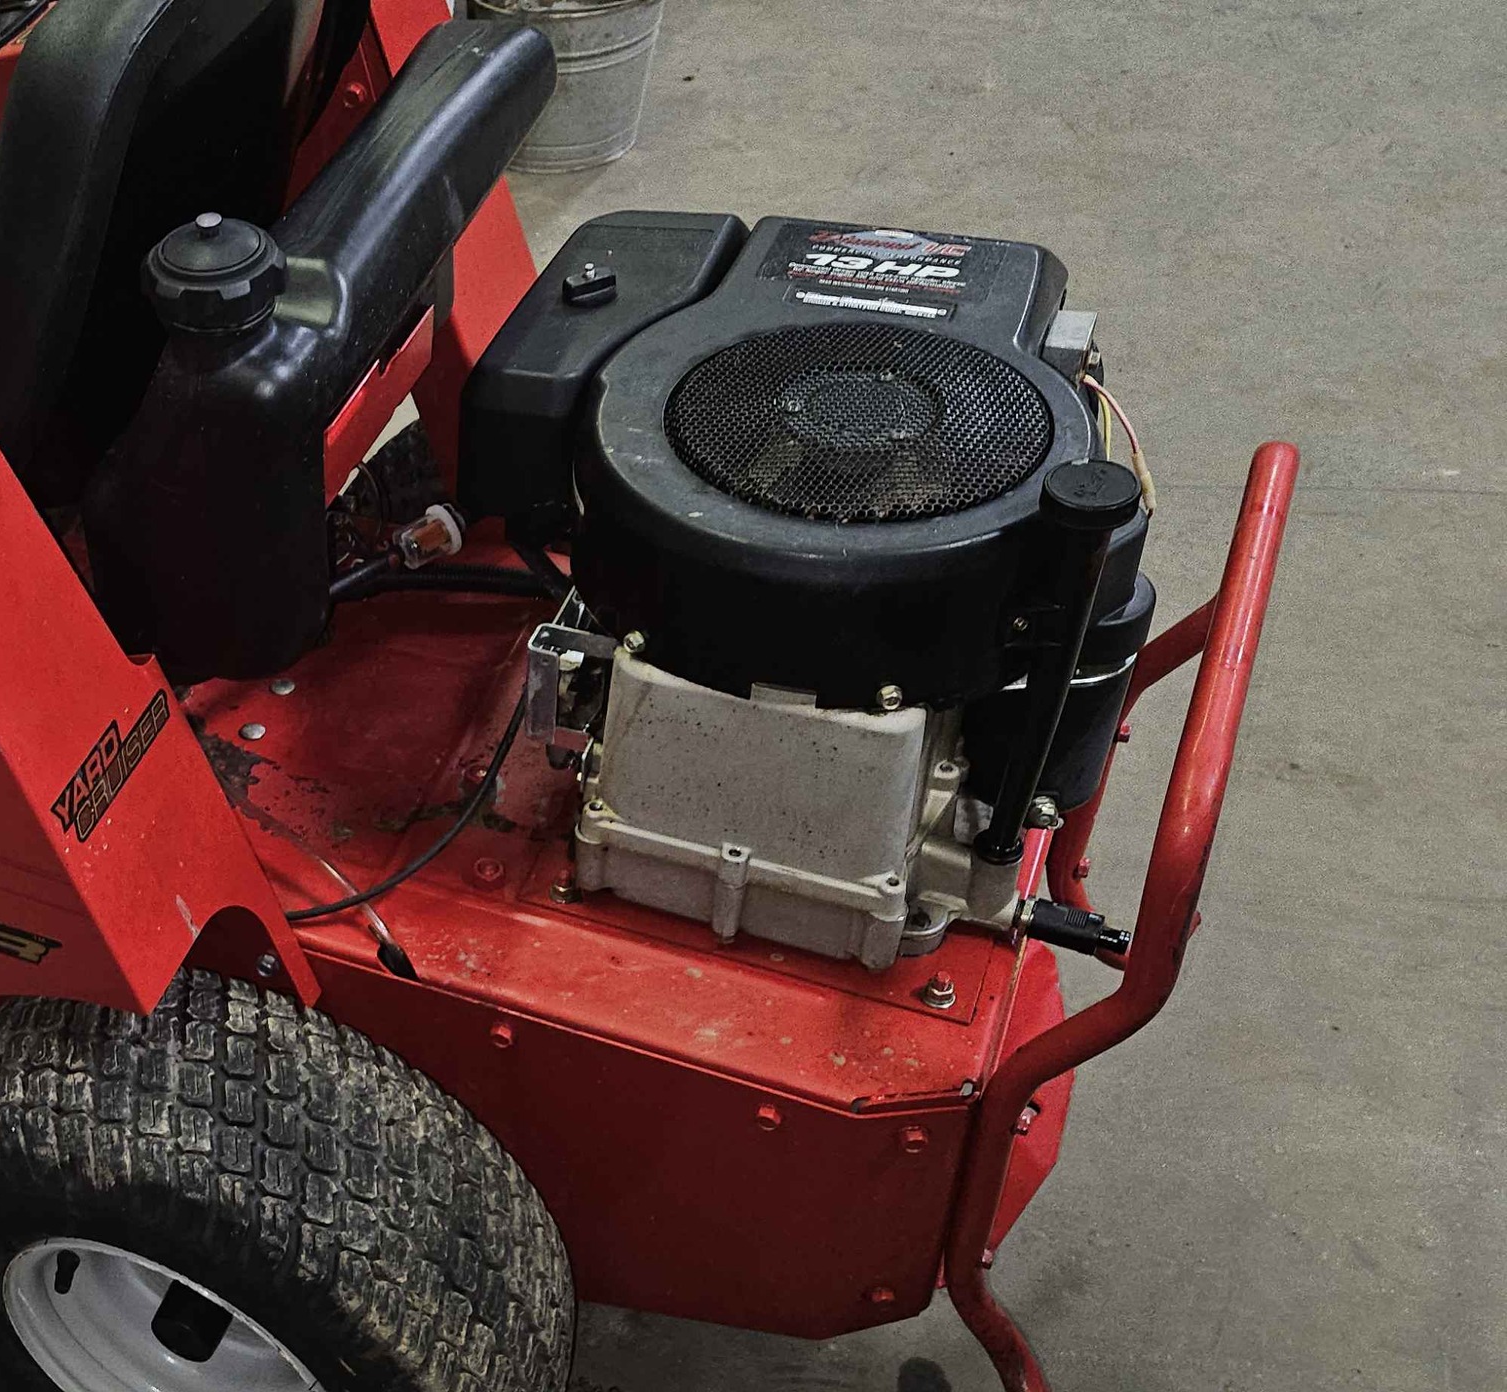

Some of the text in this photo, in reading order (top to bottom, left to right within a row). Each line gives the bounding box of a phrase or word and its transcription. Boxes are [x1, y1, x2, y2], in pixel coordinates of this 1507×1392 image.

[805, 253, 873, 270] 13
[873, 260, 961, 278] HP
[52, 725, 121, 828] YARD
[75, 693, 169, 841] CRUISER
